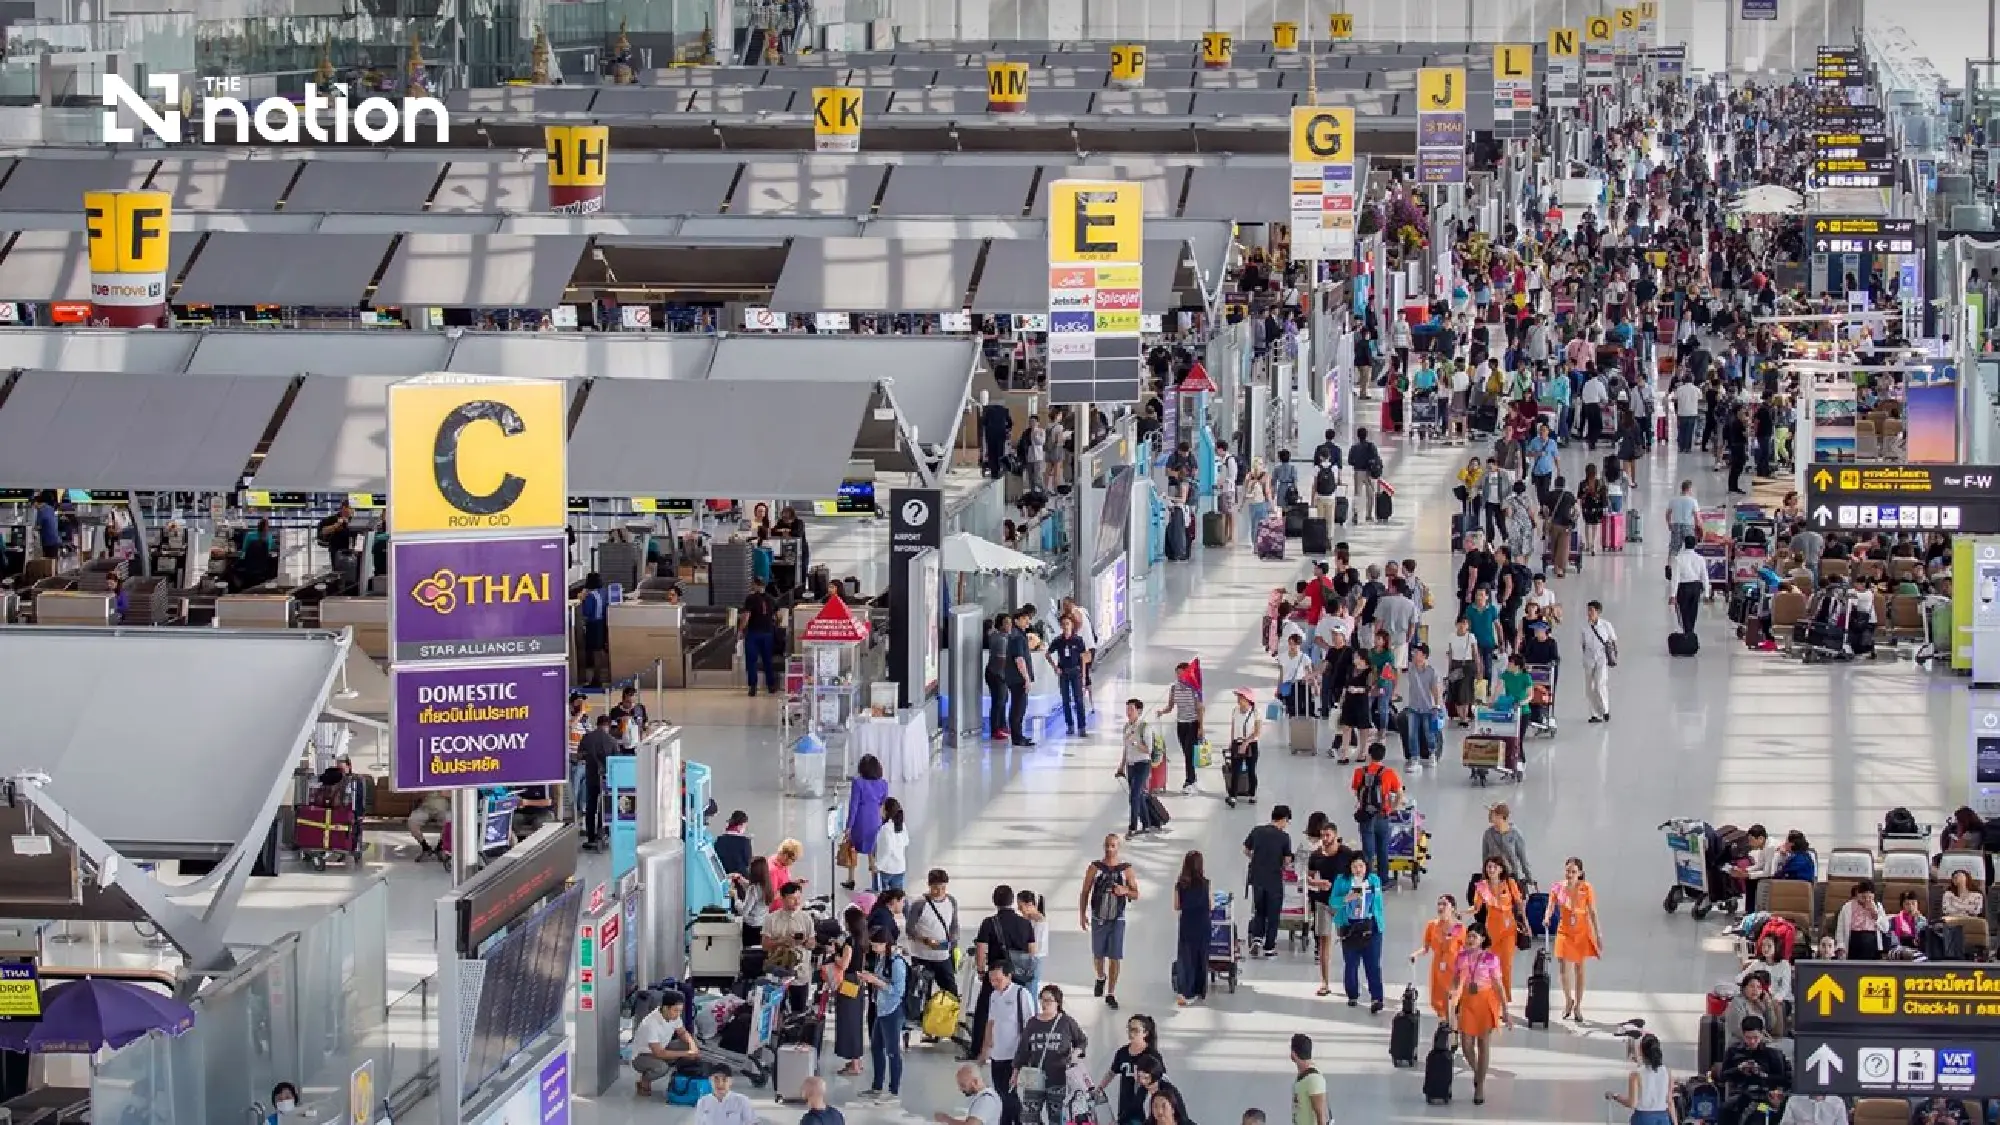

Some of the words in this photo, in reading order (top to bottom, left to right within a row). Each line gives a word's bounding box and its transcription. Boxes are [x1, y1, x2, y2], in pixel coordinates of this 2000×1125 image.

[1592, 19, 1608, 40] Q
[1621, 11, 1632, 27] S
[1288, 26, 1298, 43] T
[1555, 31, 1572, 54] N
[1220, 38, 1231, 55] R
[1132, 52, 1144, 72] P
[1505, 49, 1522, 75] L
[1009, 71, 1027, 95] M
[1431, 74, 1452, 105] J
[840, 97, 859, 127] K
[1306, 114, 1341, 155] G
[578, 139, 603, 175] H
[1074, 192, 1118, 252] E
[132, 209, 162, 259] F
[111, 284, 146, 297] move
[434, 400, 526, 514] C
[1964, 475, 1992, 488] F-W
[449, 515, 480, 527] ROW
[458, 573, 550, 604] THAI
[420, 643, 455, 657] STAR
[458, 640, 526, 655] ALLIANCE
[419, 682, 518, 703] DOMESTIC
[430, 732, 530, 754] ECONOMY
[1904, 1001, 1960, 1015] Check-in
[1942, 1053, 1971, 1066] VAT
